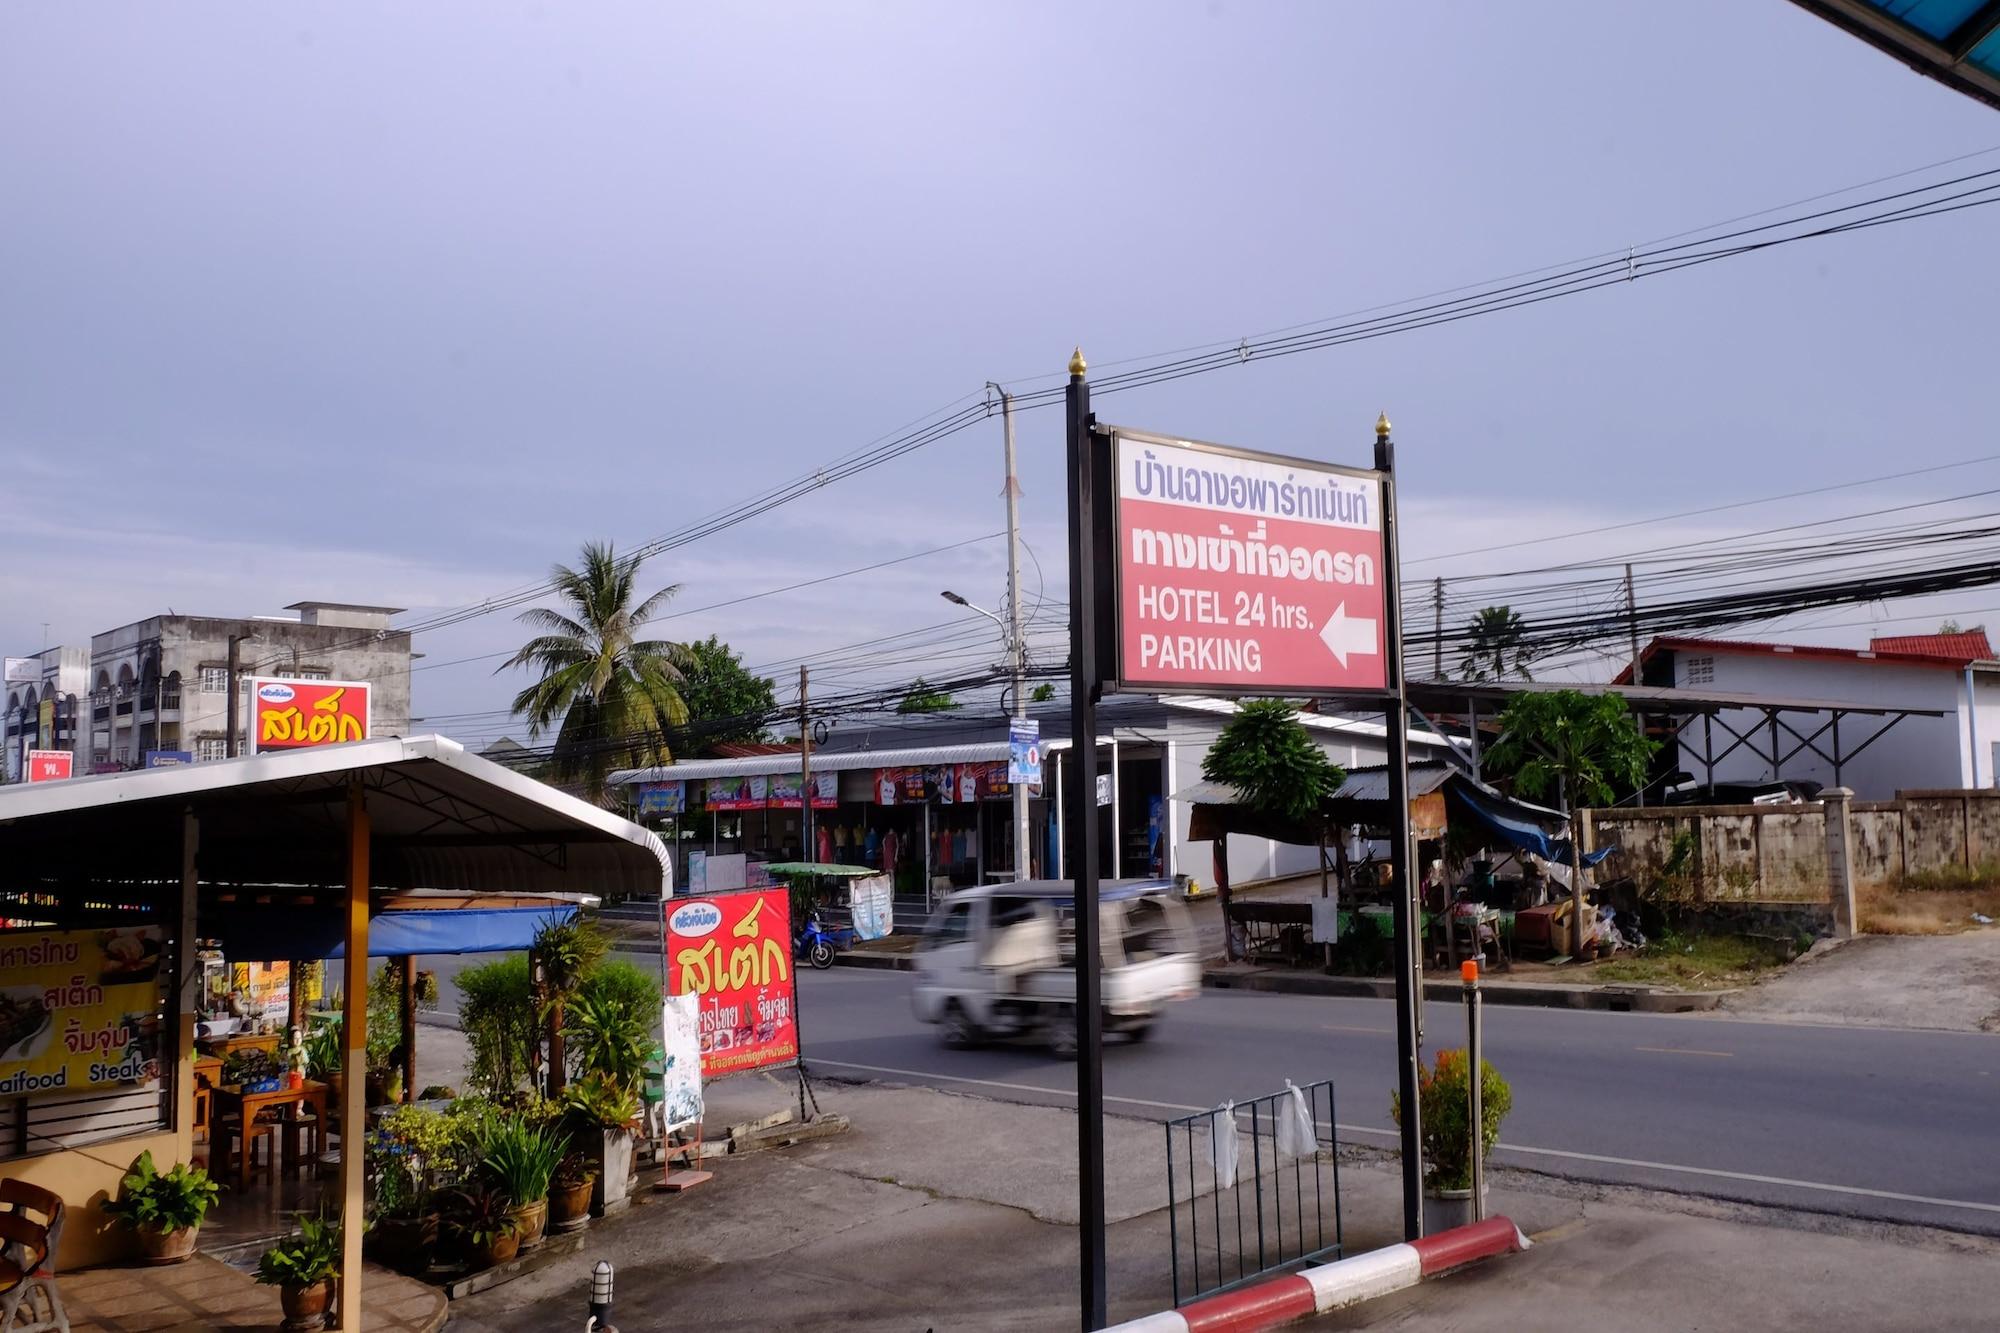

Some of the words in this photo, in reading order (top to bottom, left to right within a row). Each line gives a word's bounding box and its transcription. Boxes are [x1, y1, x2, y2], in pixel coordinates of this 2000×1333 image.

[1134, 449, 1368, 525] บ้านฉางอพาร์ทเม้นท์
[1131, 520, 1374, 586] ทางเข้าที่จอดรถ
[1138, 584, 1229, 625] HOTEL
[1234, 591, 1265, 627] 24
[1271, 595, 1314, 630] hrs.
[1140, 633, 1262, 672] PARKING
[260, 687, 364, 743] สเต็ก
[677, 896, 788, 994] สเต็ก
[44, 975, 102, 1005] สเต็ก
[64, 1019, 130, 1057] จิ้มจุ่ม
[89, 1062, 144, 1082] Steak
